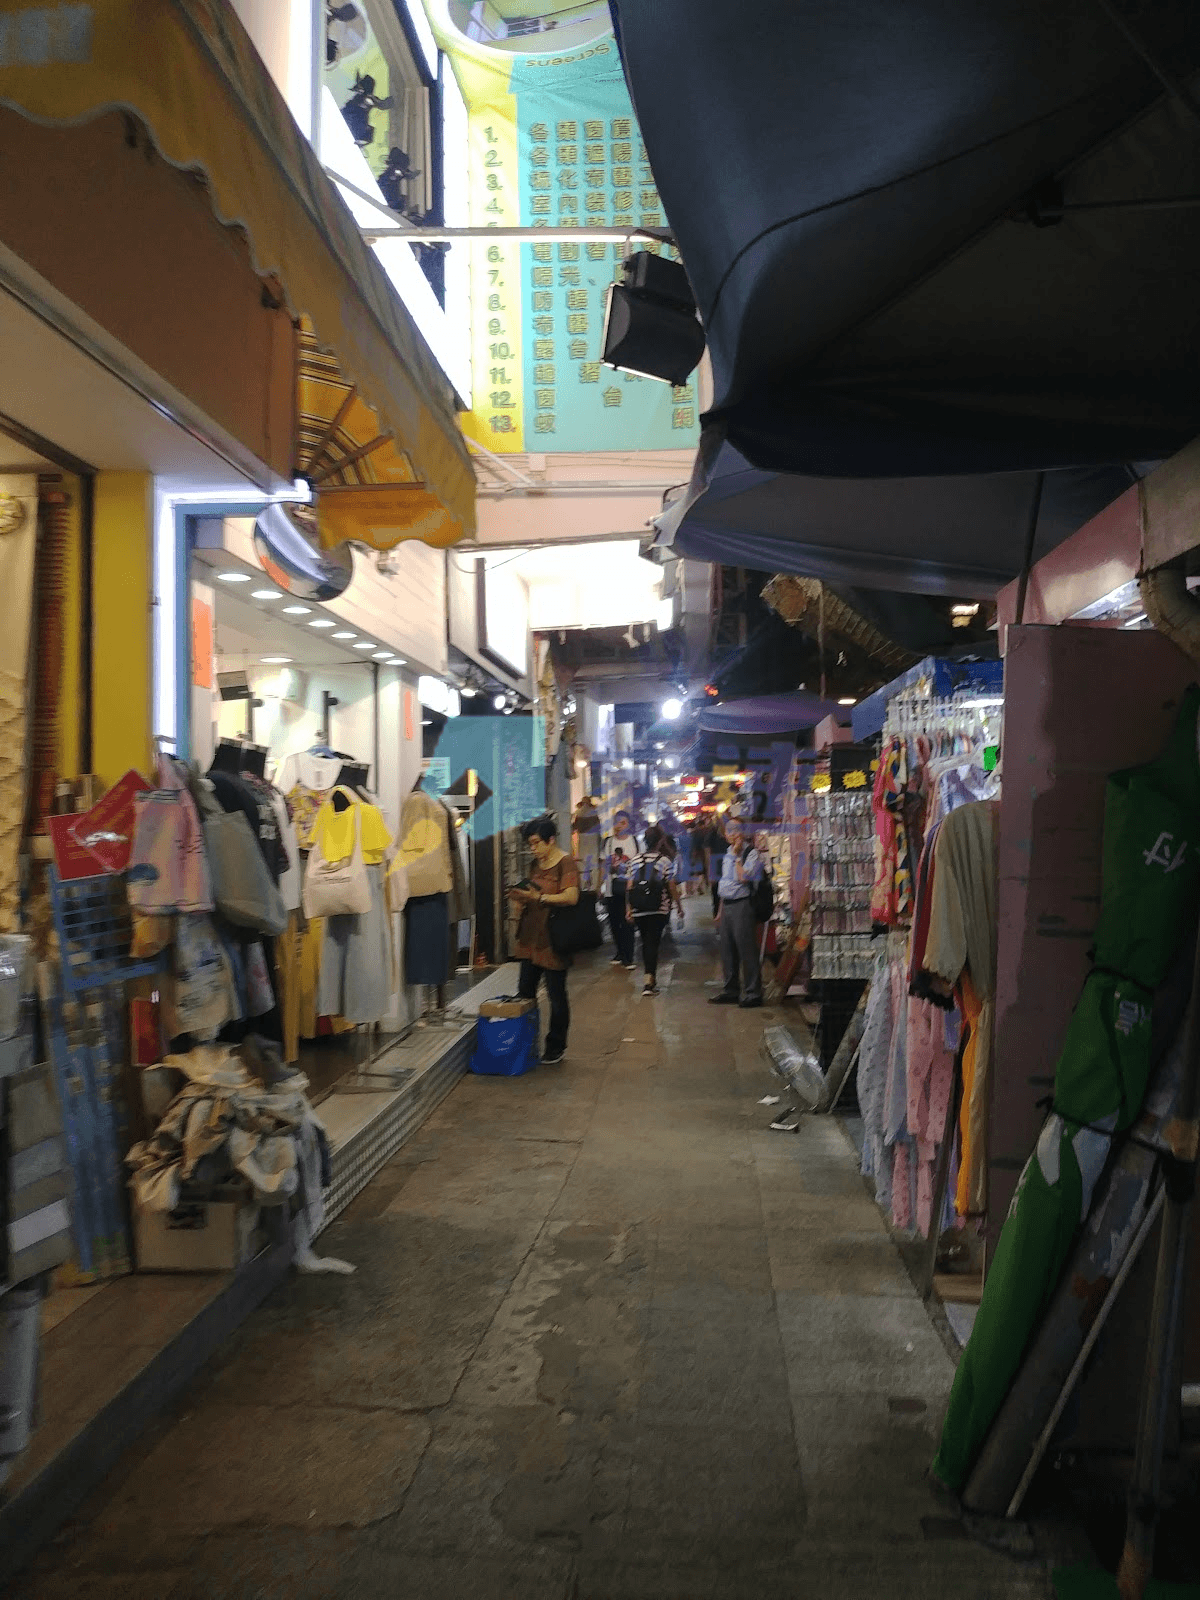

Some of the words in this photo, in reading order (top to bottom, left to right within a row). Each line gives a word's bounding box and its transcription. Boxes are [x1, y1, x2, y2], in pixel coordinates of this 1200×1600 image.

[526, 43, 611, 68] Screens
[488, 342, 515, 360] 10.
[489, 367, 512, 385] 11.
[489, 390, 517, 409] 12.
[488, 414, 517, 433] 13.
